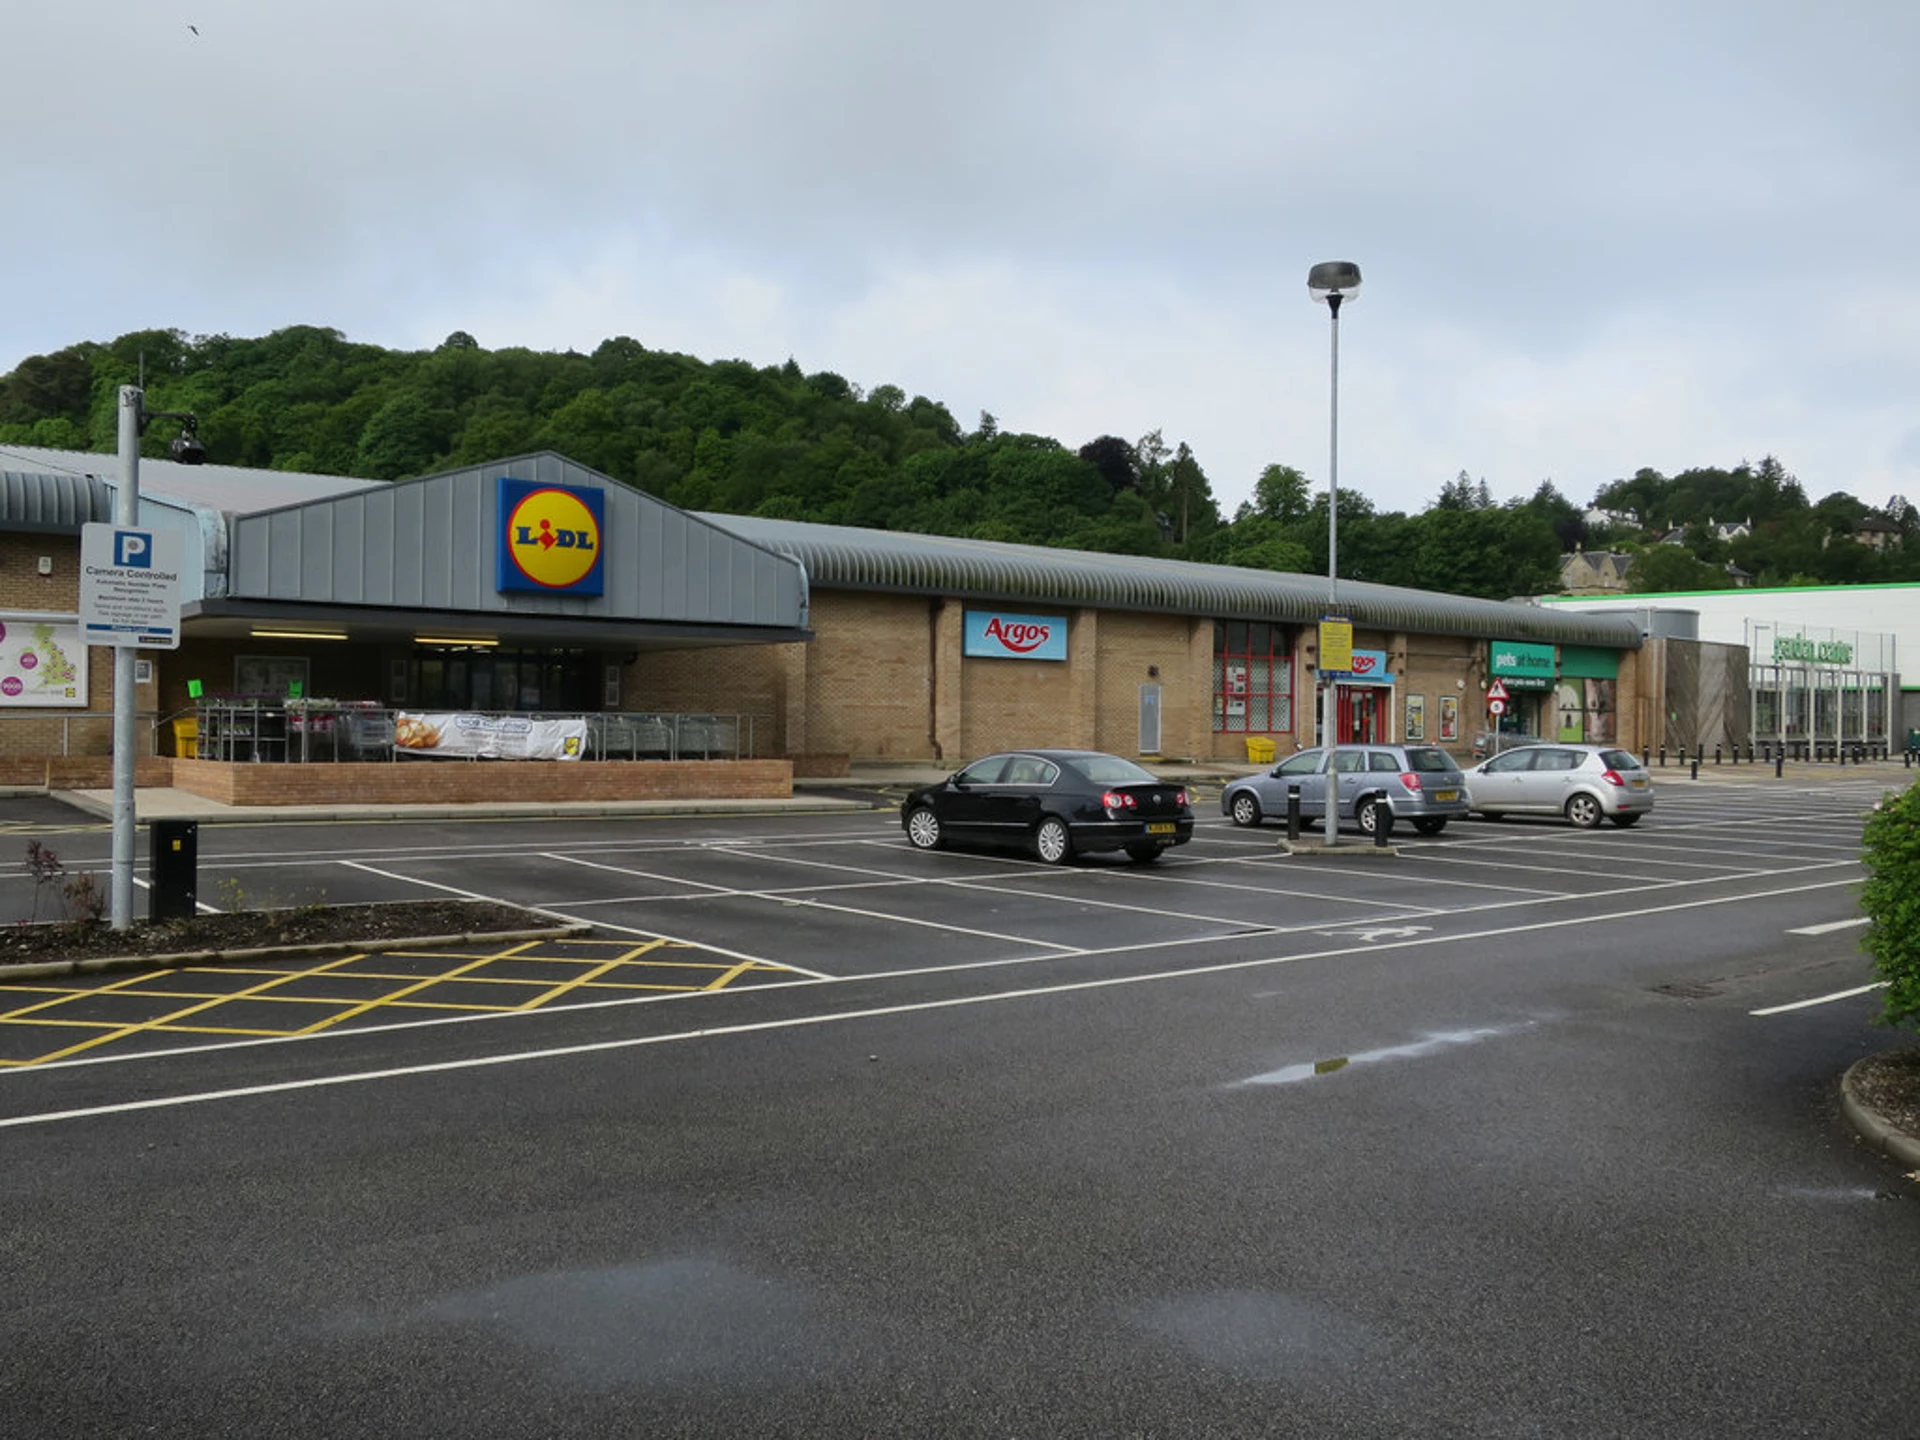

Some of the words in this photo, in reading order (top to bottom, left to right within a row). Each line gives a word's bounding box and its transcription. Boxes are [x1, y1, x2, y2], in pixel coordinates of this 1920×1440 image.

[121, 535, 146, 564] P
[85, 565, 124, 577] Camera
[127, 569, 177, 582] Controlled
[984, 617, 1050, 653] Argos
[1772, 633, 1814, 665] garden
[1819, 640, 1853, 665] centre
[1496, 652, 1516, 668] pets
[1527, 653, 1551, 668] home
